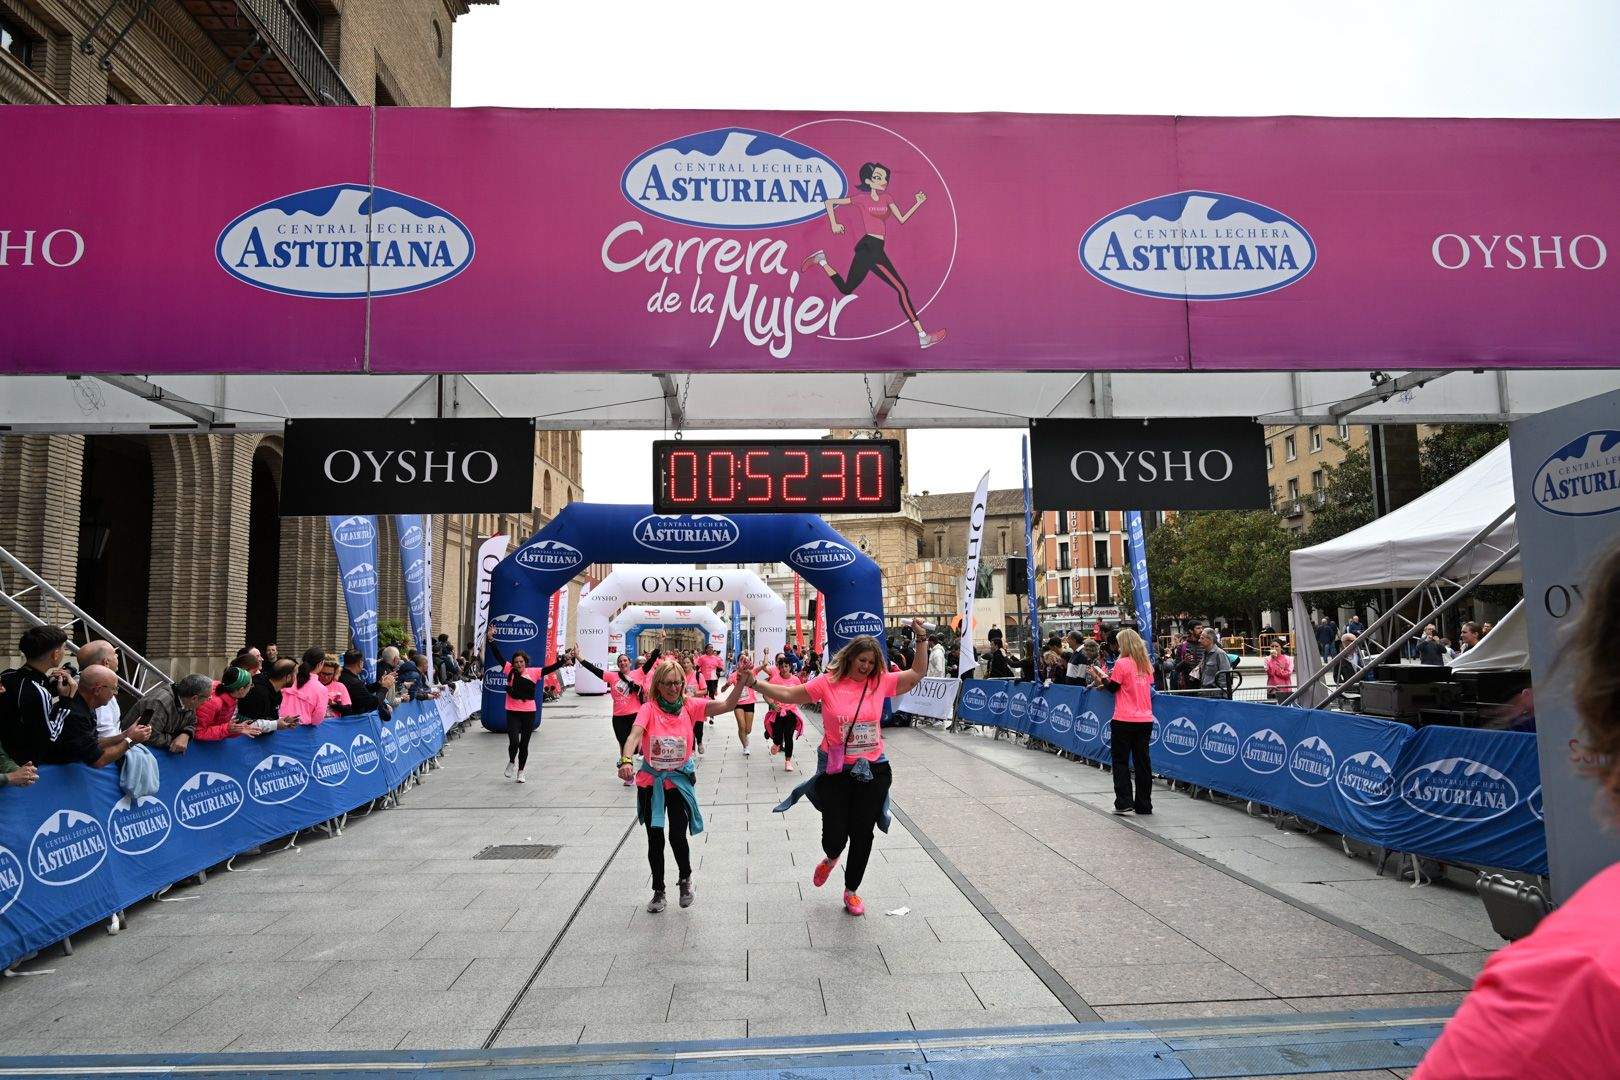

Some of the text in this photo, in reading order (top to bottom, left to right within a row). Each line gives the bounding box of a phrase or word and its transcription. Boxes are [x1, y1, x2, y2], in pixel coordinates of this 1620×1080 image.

[674, 162, 823, 173] CENTRAL LECHERA
[639, 164, 830, 203] ASTURIANA
[277, 224, 447, 235] CENTRAL LECHERA
[1134, 229, 1290, 239] CENTRAL LECHERA
[235, 226, 455, 268] ASTURIANA
[601, 221, 788, 275] Carrera
[1098, 231, 1299, 272] ASTURIANA
[1431, 233, 1608, 271] OYSHO
[646, 271, 858, 359] de la Mujer
[323, 449, 499, 484] OYSHO
[1070, 449, 1233, 483] OYSHO
[1558, 456, 1620, 476] CENTRAL LE
[1542, 470, 1620, 503] ASTURI
[641, 522, 732, 542] ASTURIANA
[519, 551, 577, 564] ASTURIANA
[796, 551, 852, 563] ASTURIANA
[642, 575, 724, 593] OYSHO
[1164, 729, 1195, 748] ASTURIANA
[1202, 736, 1235, 756] ASTURIANA
[1243, 742, 1283, 766] ASTURIANA
[316, 760, 349, 779] ASTURIANA
[253, 772, 306, 797] ASTURIANA
[1406, 777, 1508, 809] ASTURIANA
[180, 790, 241, 822] ASTURIANA
[45, 825, 98, 849] CENTRAL LECHERA
[114, 813, 169, 845] ASTURIANA
[38, 834, 105, 876] ASTURIANA
